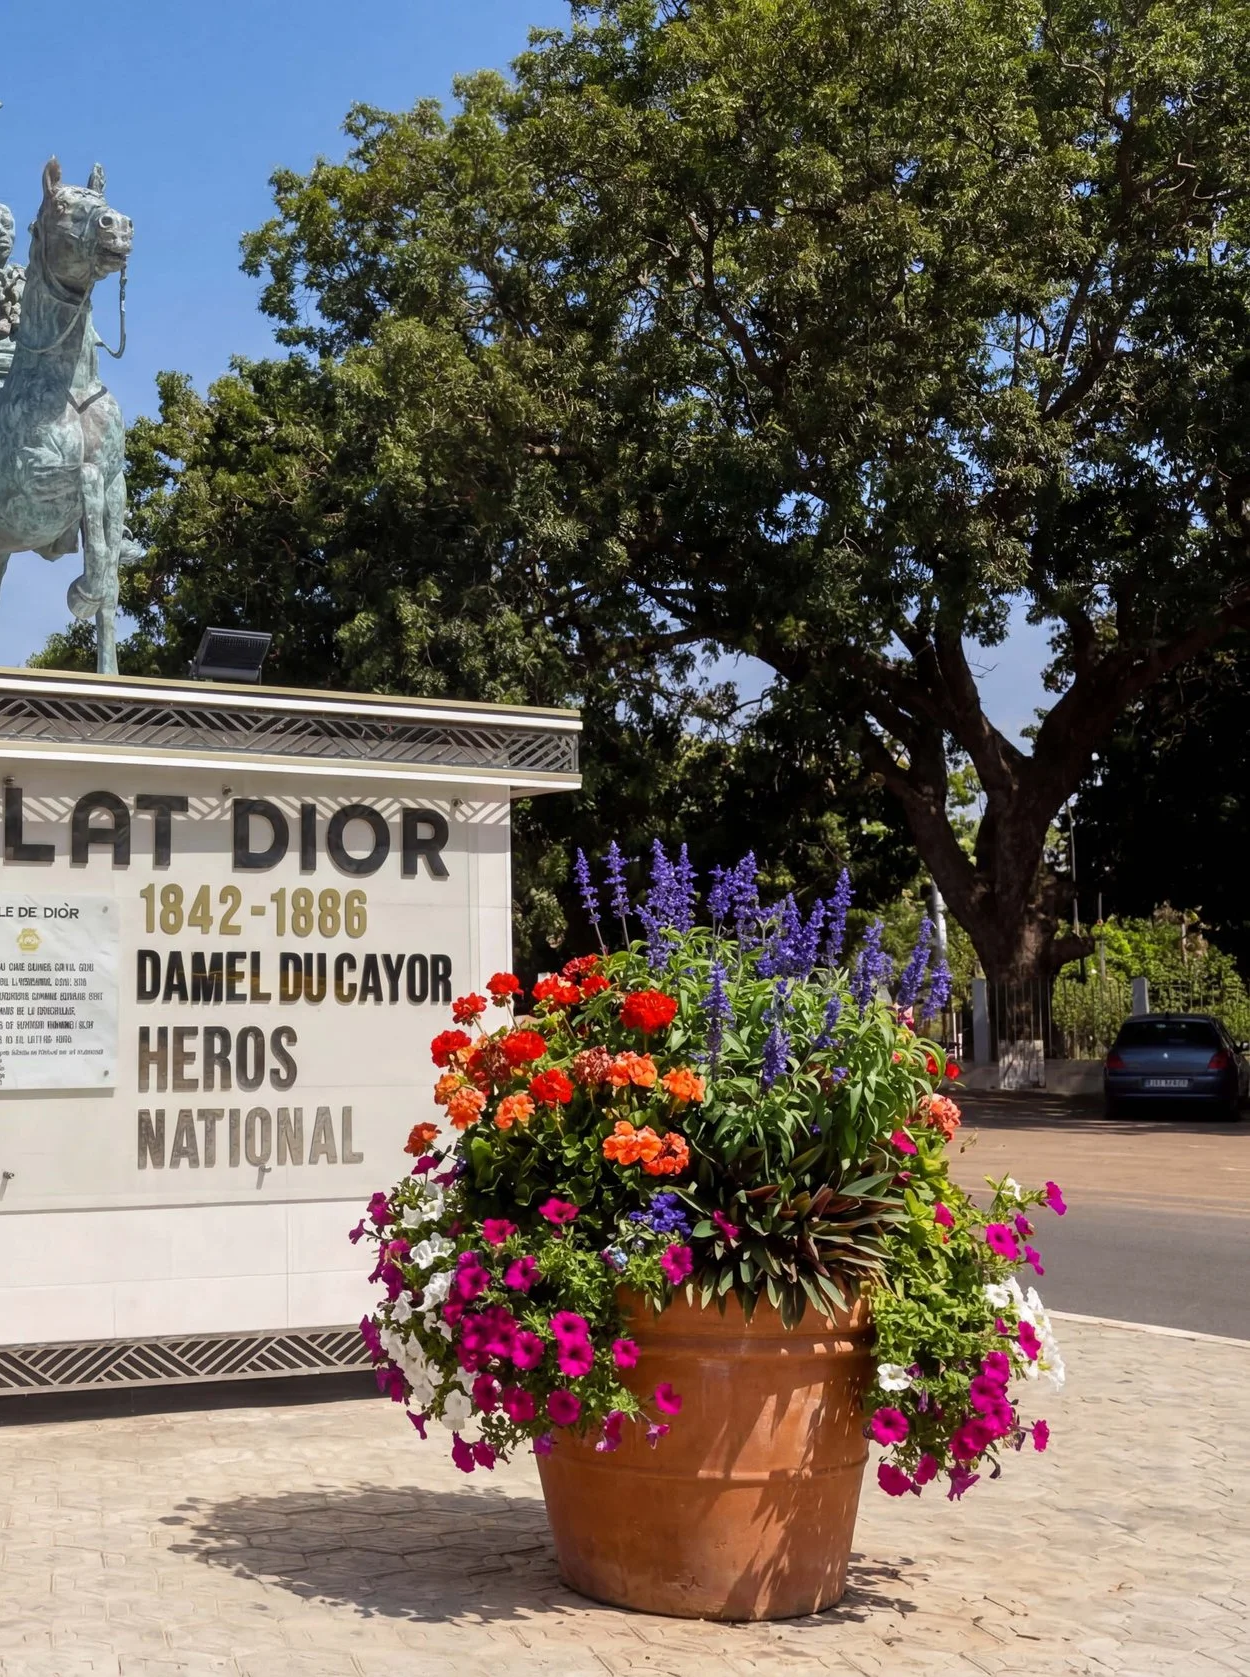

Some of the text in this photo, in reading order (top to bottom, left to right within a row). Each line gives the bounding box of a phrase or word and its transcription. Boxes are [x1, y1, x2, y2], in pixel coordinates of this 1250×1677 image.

[3, 787, 450, 878] LAT DIOR
[18, 906, 38, 918] DE
[136, 949, 272, 1003] DAMEL
[137, 1026, 298, 1093] HEROS
[137, 1106, 364, 1171] NATIONAL
